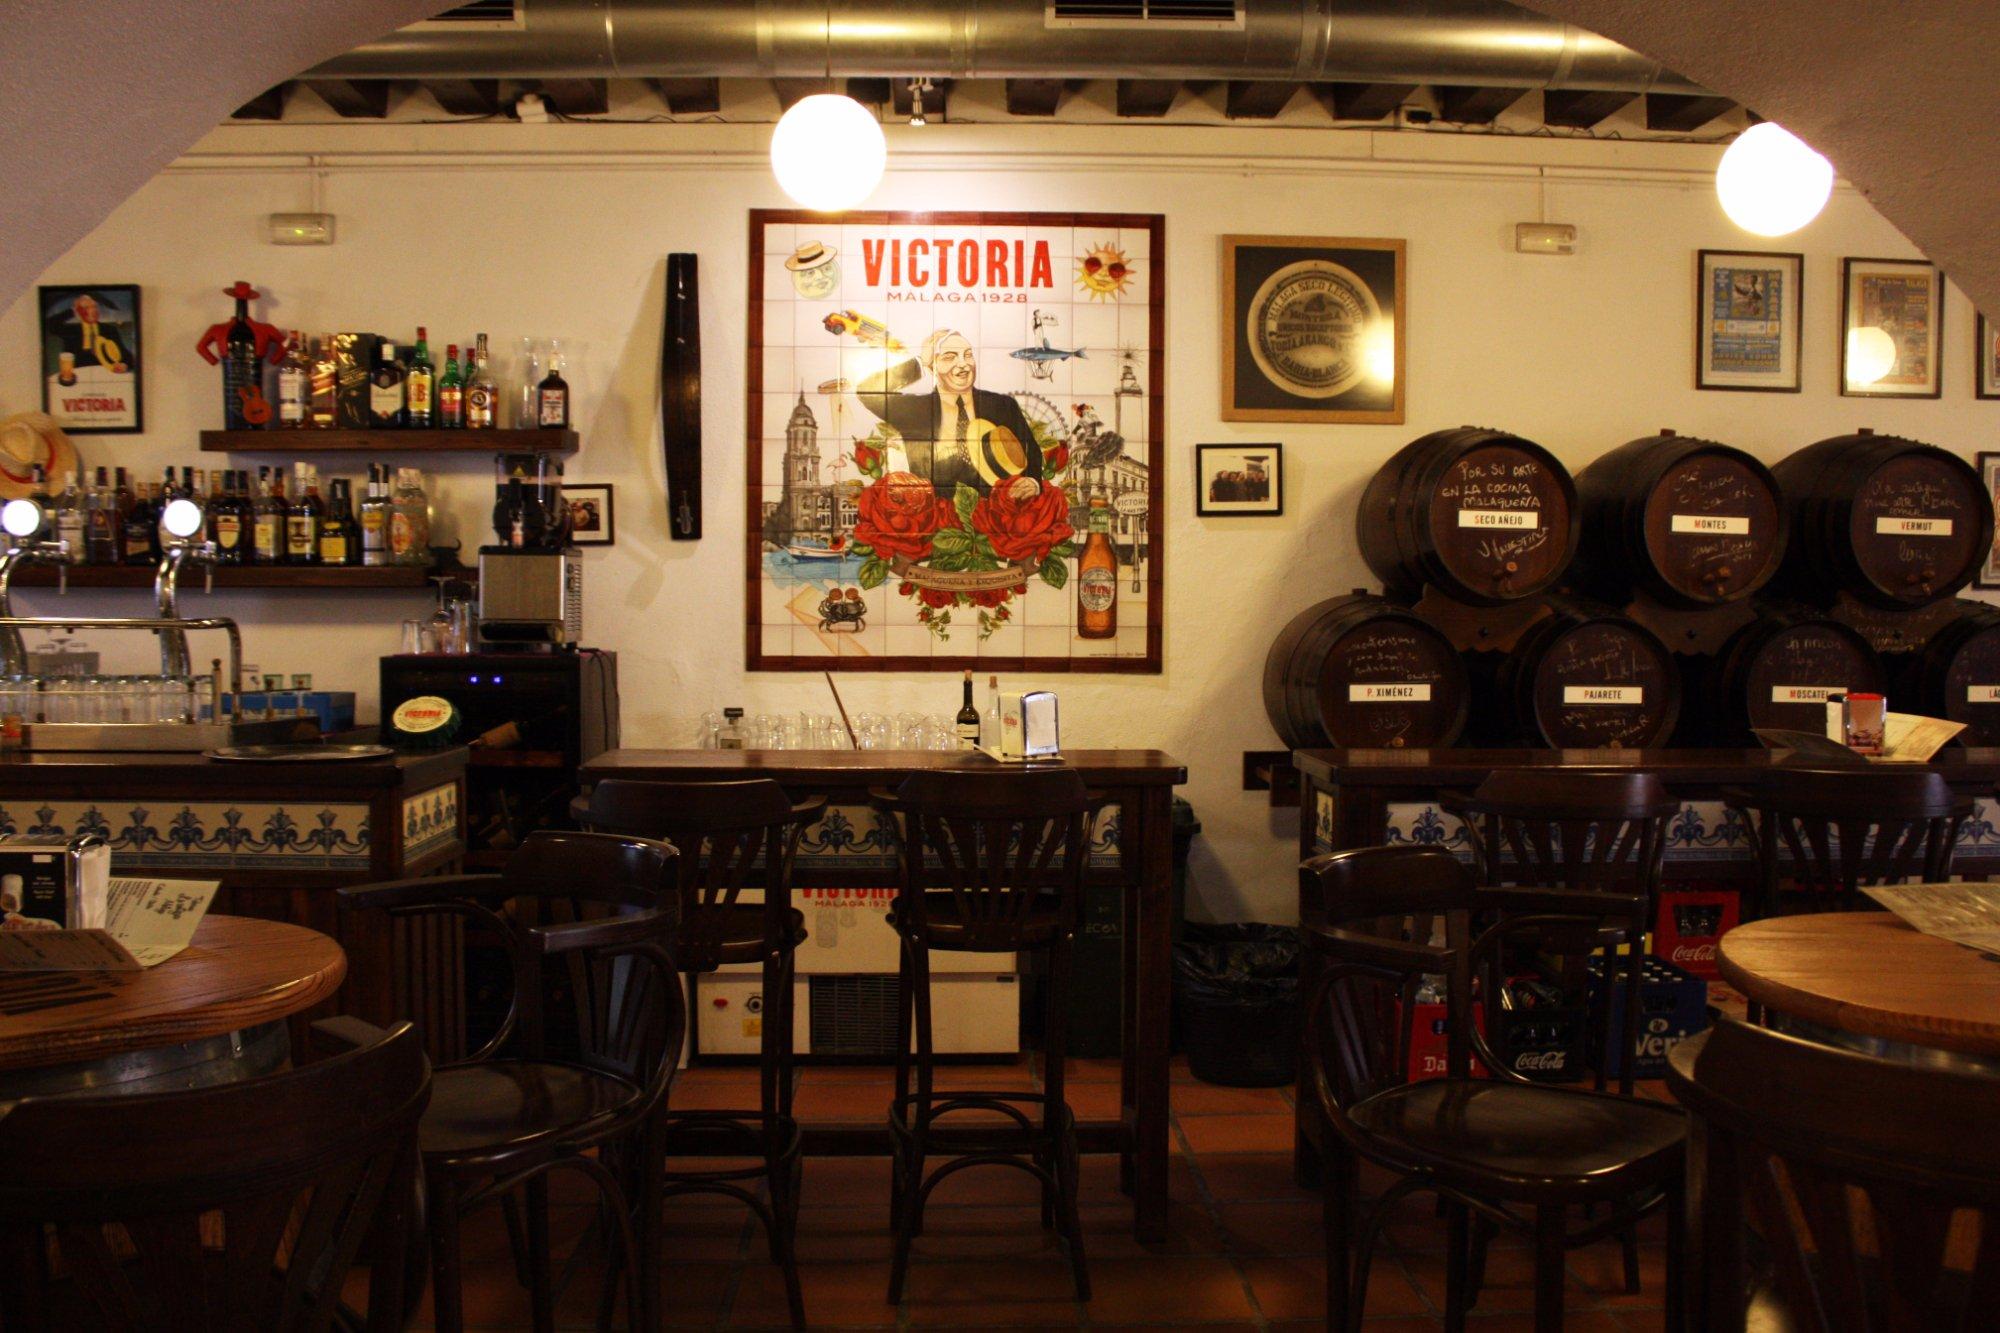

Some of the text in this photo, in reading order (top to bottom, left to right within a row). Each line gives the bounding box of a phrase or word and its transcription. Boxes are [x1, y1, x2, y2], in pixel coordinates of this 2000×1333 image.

[862, 238, 1054, 288] VICTORIA
[981, 292, 1028, 303] 1928
[61, 397, 126, 412] VICTORIA
[1490, 463, 1506, 476] SU
[1474, 514, 1523, 525] SECO AÑEJO
[1694, 519, 1727, 529] MONTES
[1901, 521, 1933, 531] VERMUT
[1367, 687, 1414, 697] P. XIMÉNEZ
[1584, 690, 1622, 699] PAJARETE
